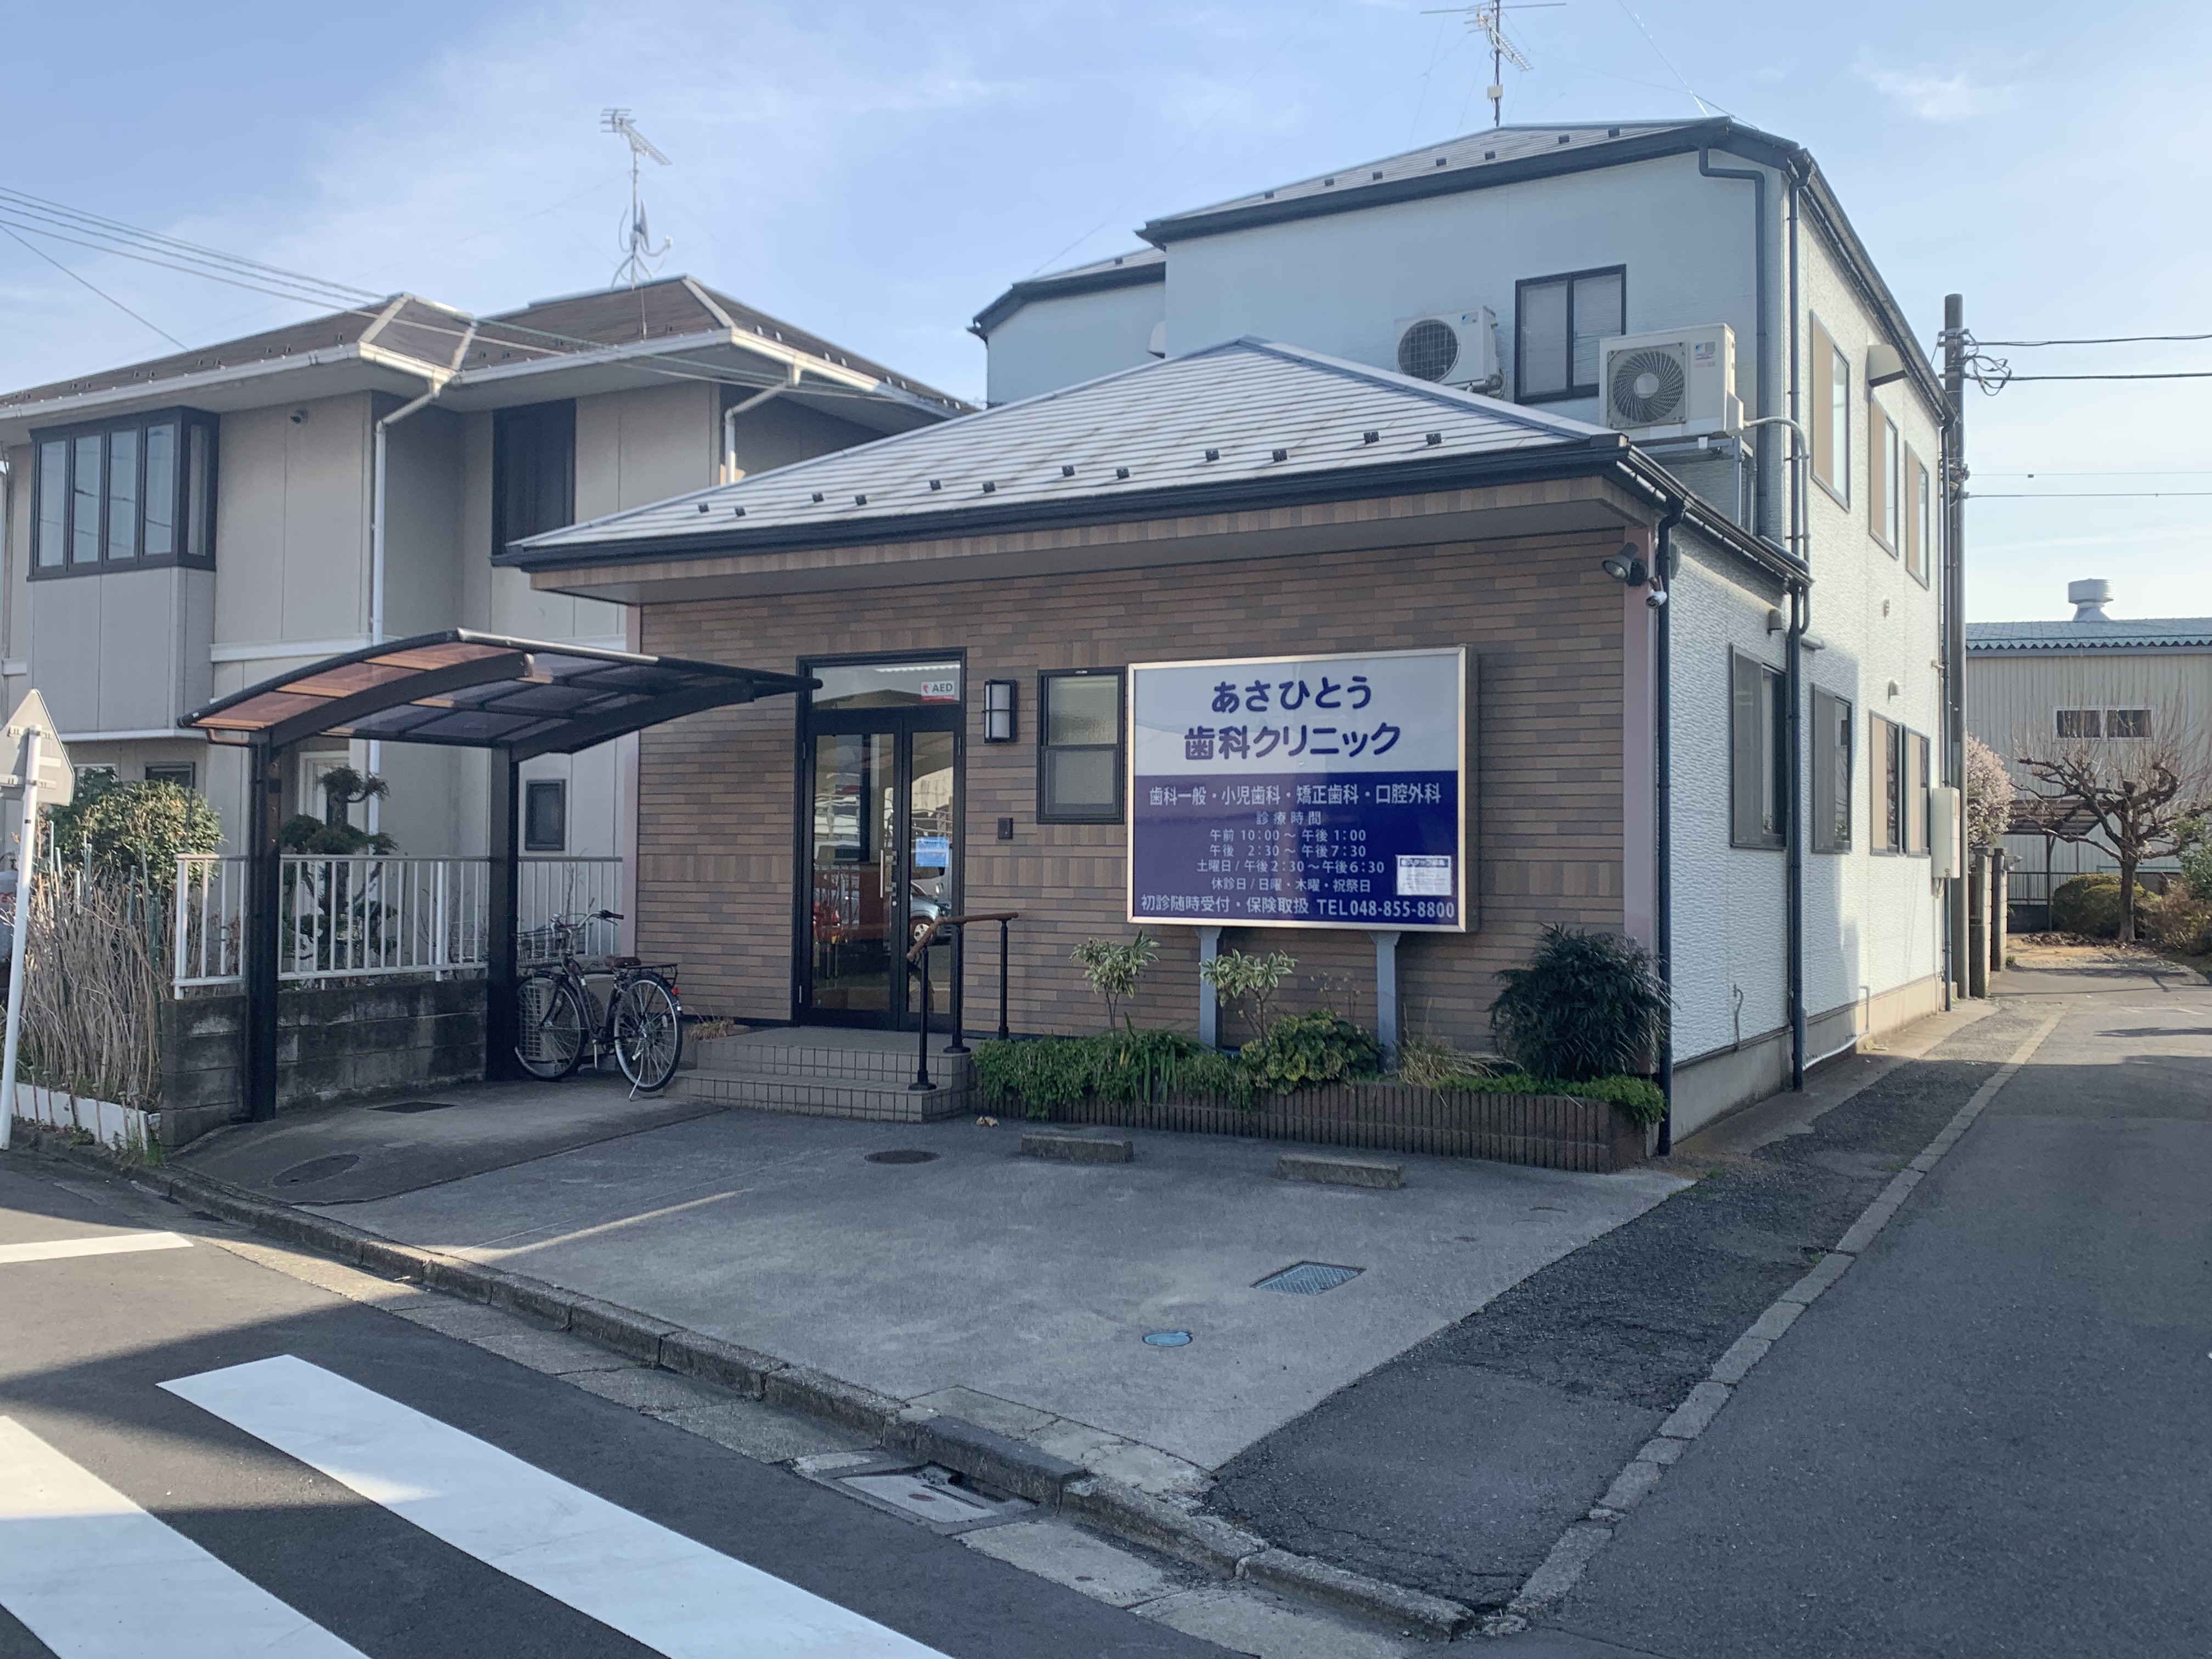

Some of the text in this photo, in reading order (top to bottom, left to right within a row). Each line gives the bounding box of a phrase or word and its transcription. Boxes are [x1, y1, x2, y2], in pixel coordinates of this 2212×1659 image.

[932, 682, 953, 692] AED
[1212, 676, 1372, 713] あさひとう
[1184, 722, 1401, 760] 歯科クリニック
[1256, 811, 1322, 825] 診療時間
